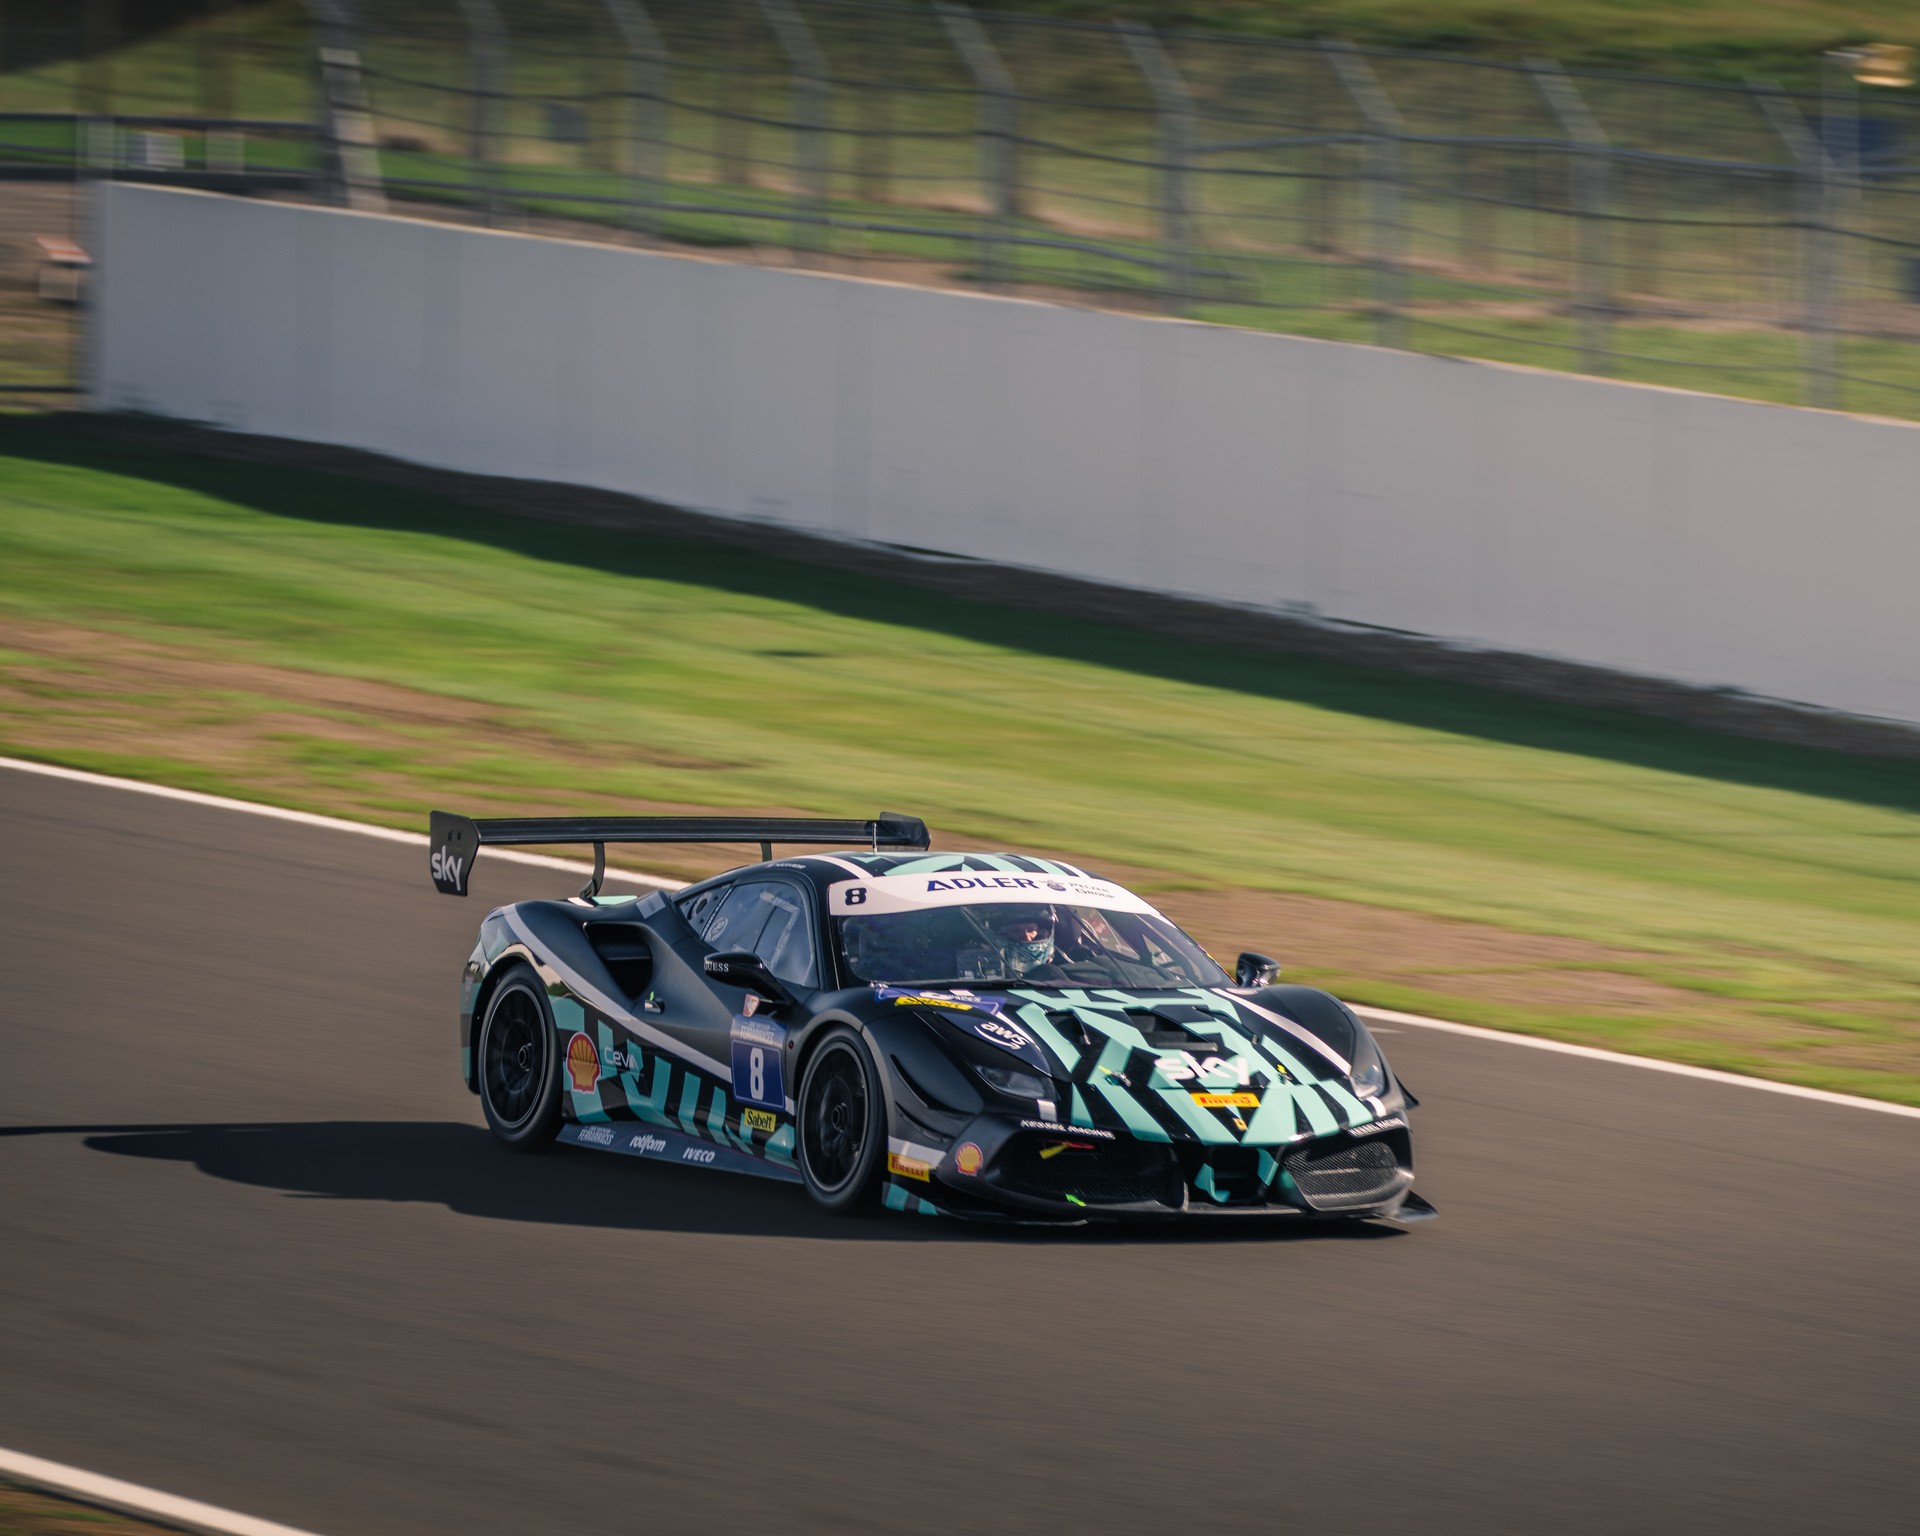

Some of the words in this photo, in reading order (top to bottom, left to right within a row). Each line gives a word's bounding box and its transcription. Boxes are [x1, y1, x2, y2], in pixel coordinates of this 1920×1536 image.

[431, 845, 462, 891] sky
[926, 877, 1040, 892] ADLER
[844, 887, 867, 906] 8
[981, 1021, 1030, 1046] aws
[750, 1047, 764, 1100] 8
[1154, 1051, 1250, 1086] sky
[747, 1108, 773, 1130] Sabelt
[683, 1147, 716, 1163] IVECO
